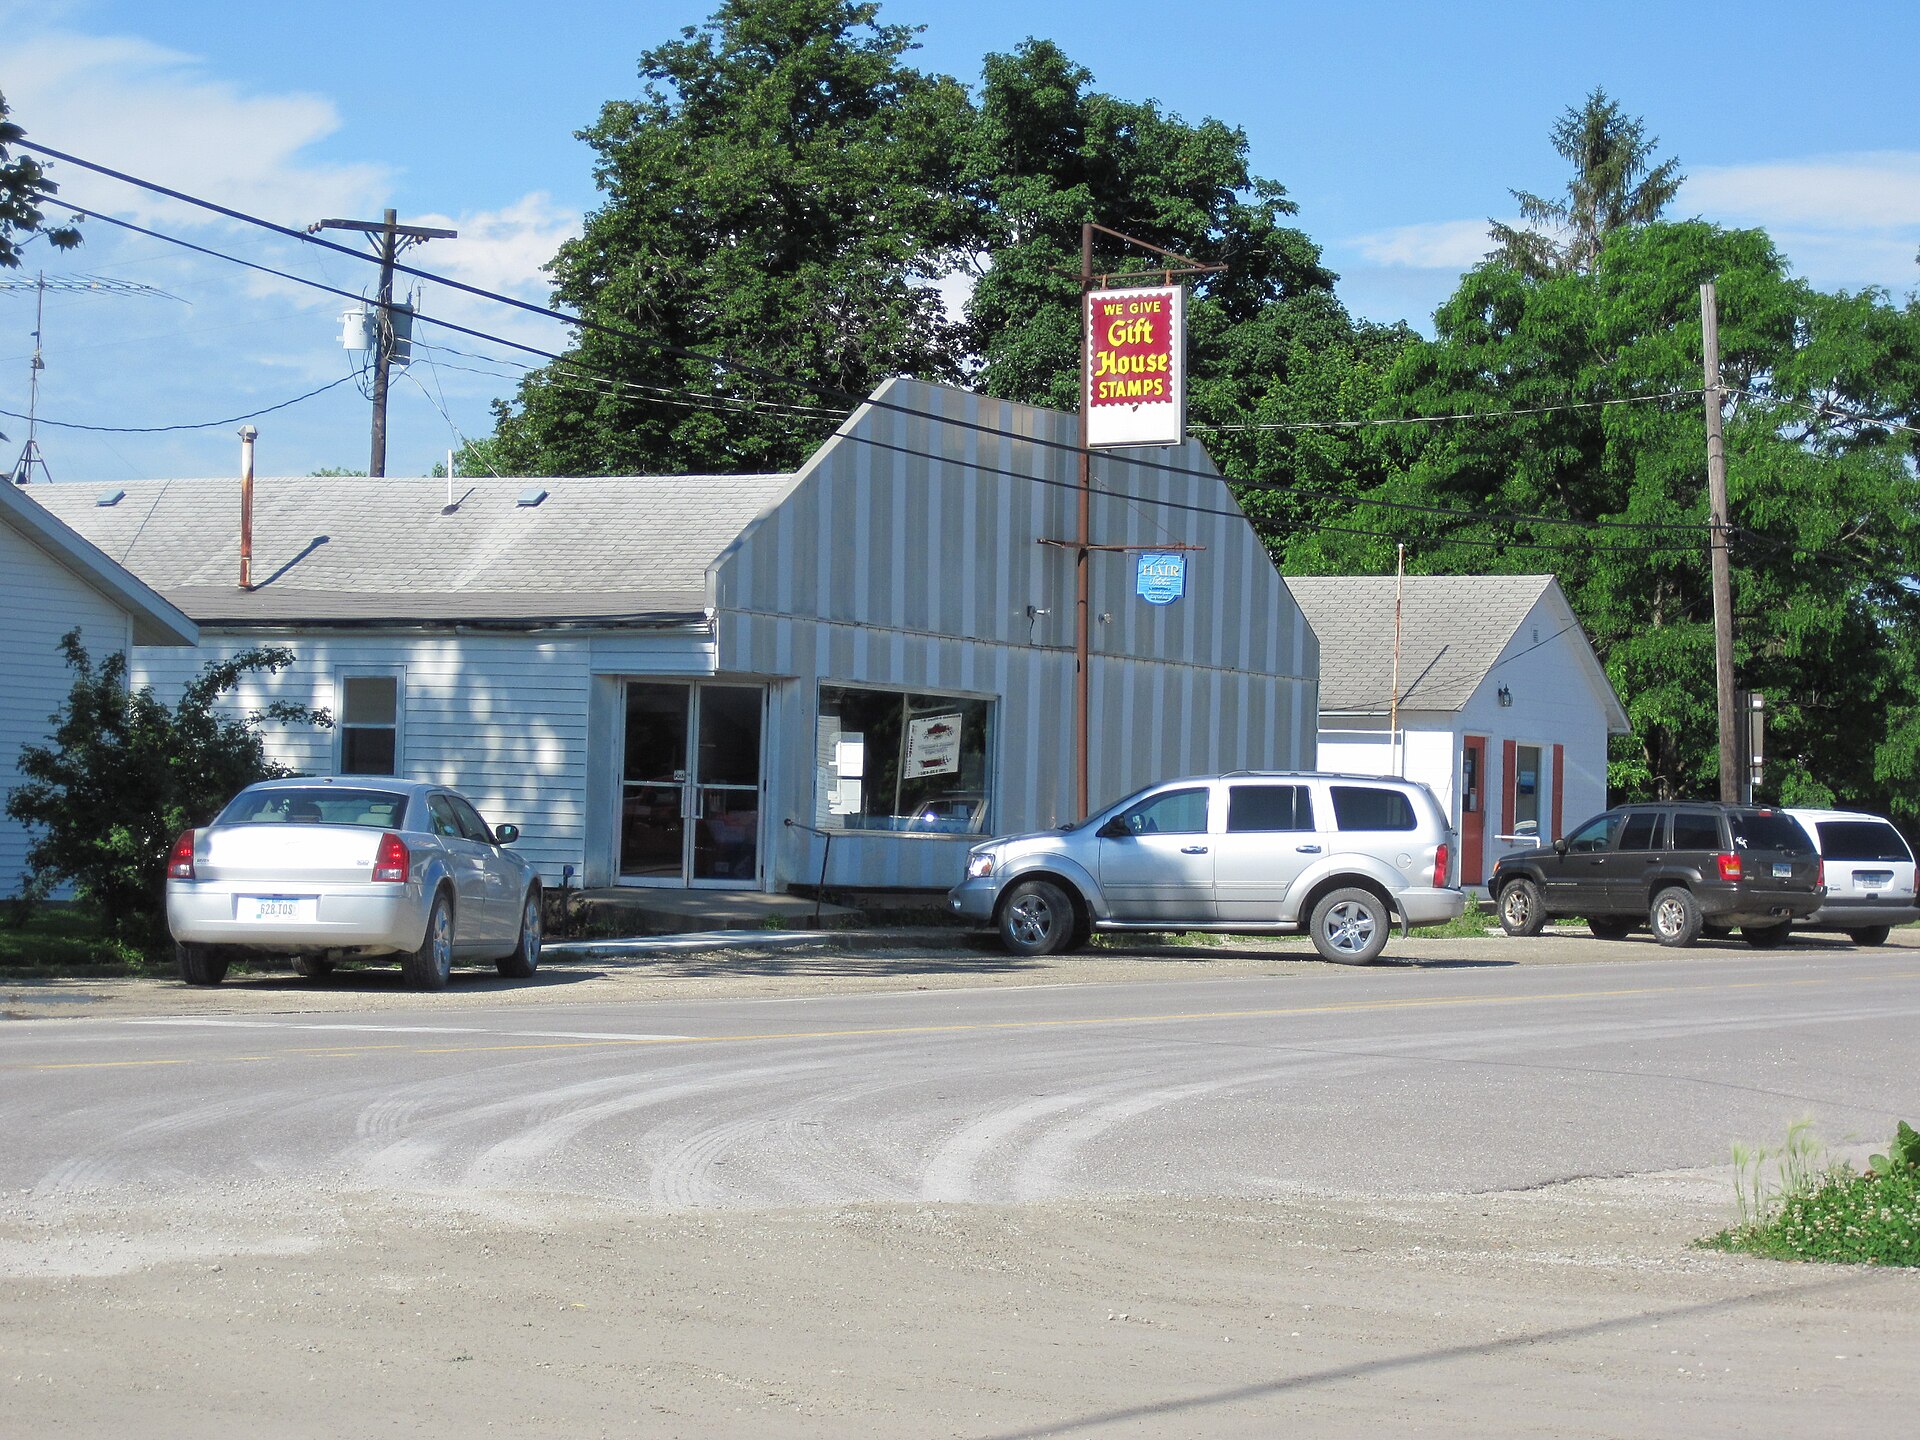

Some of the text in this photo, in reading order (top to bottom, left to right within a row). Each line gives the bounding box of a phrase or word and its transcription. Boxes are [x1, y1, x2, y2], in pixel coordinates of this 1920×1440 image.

[1104, 301, 1161, 316] WE GIVE
[1107, 317, 1154, 347] Gift
[1094, 350, 1168, 377] House
[1098, 378, 1163, 399] STAMPS
[1142, 564, 1180, 577] HAIR
[260, 903, 276, 915] 628
